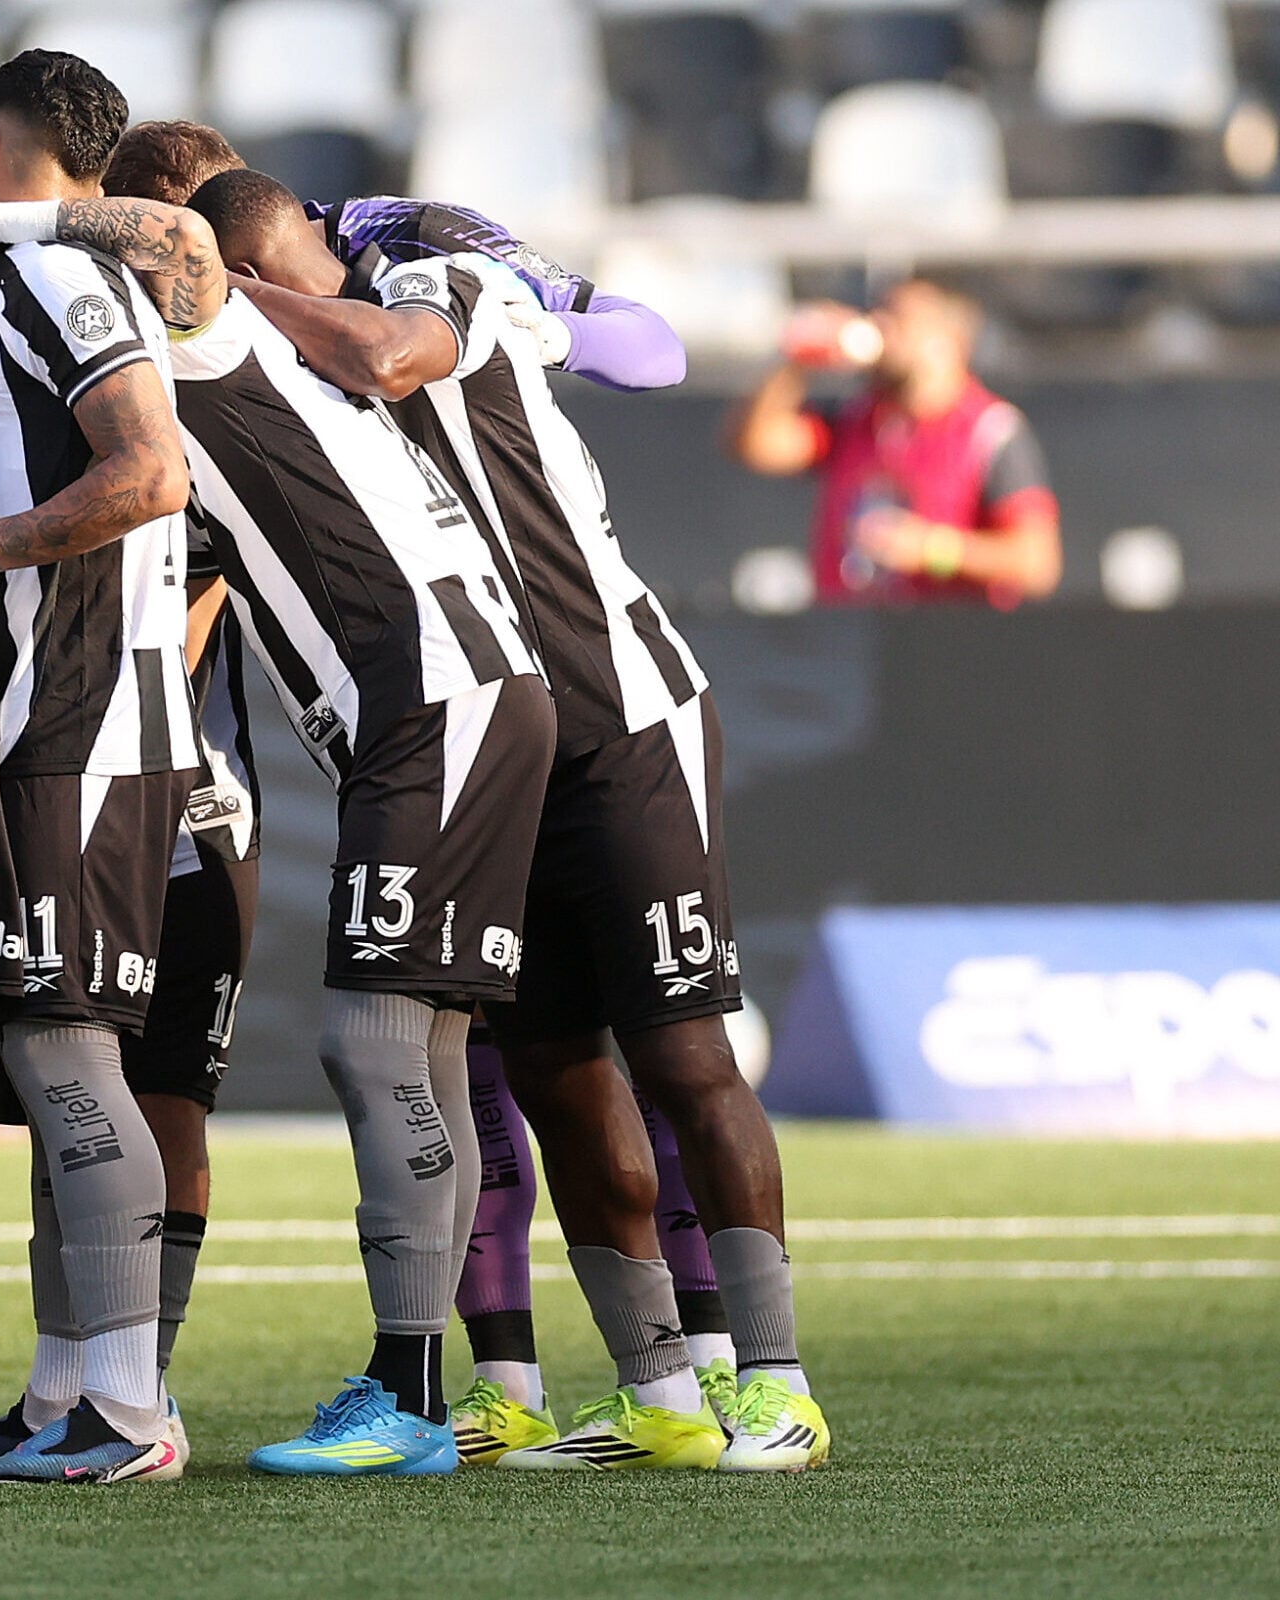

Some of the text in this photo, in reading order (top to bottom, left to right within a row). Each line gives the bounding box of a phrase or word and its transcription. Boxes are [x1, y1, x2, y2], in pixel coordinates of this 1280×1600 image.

[345, 864, 418, 938] 13
[440, 900, 455, 965] Reebok
[645, 890, 713, 975] 15
[392, 1083, 448, 1152] Lifefit
